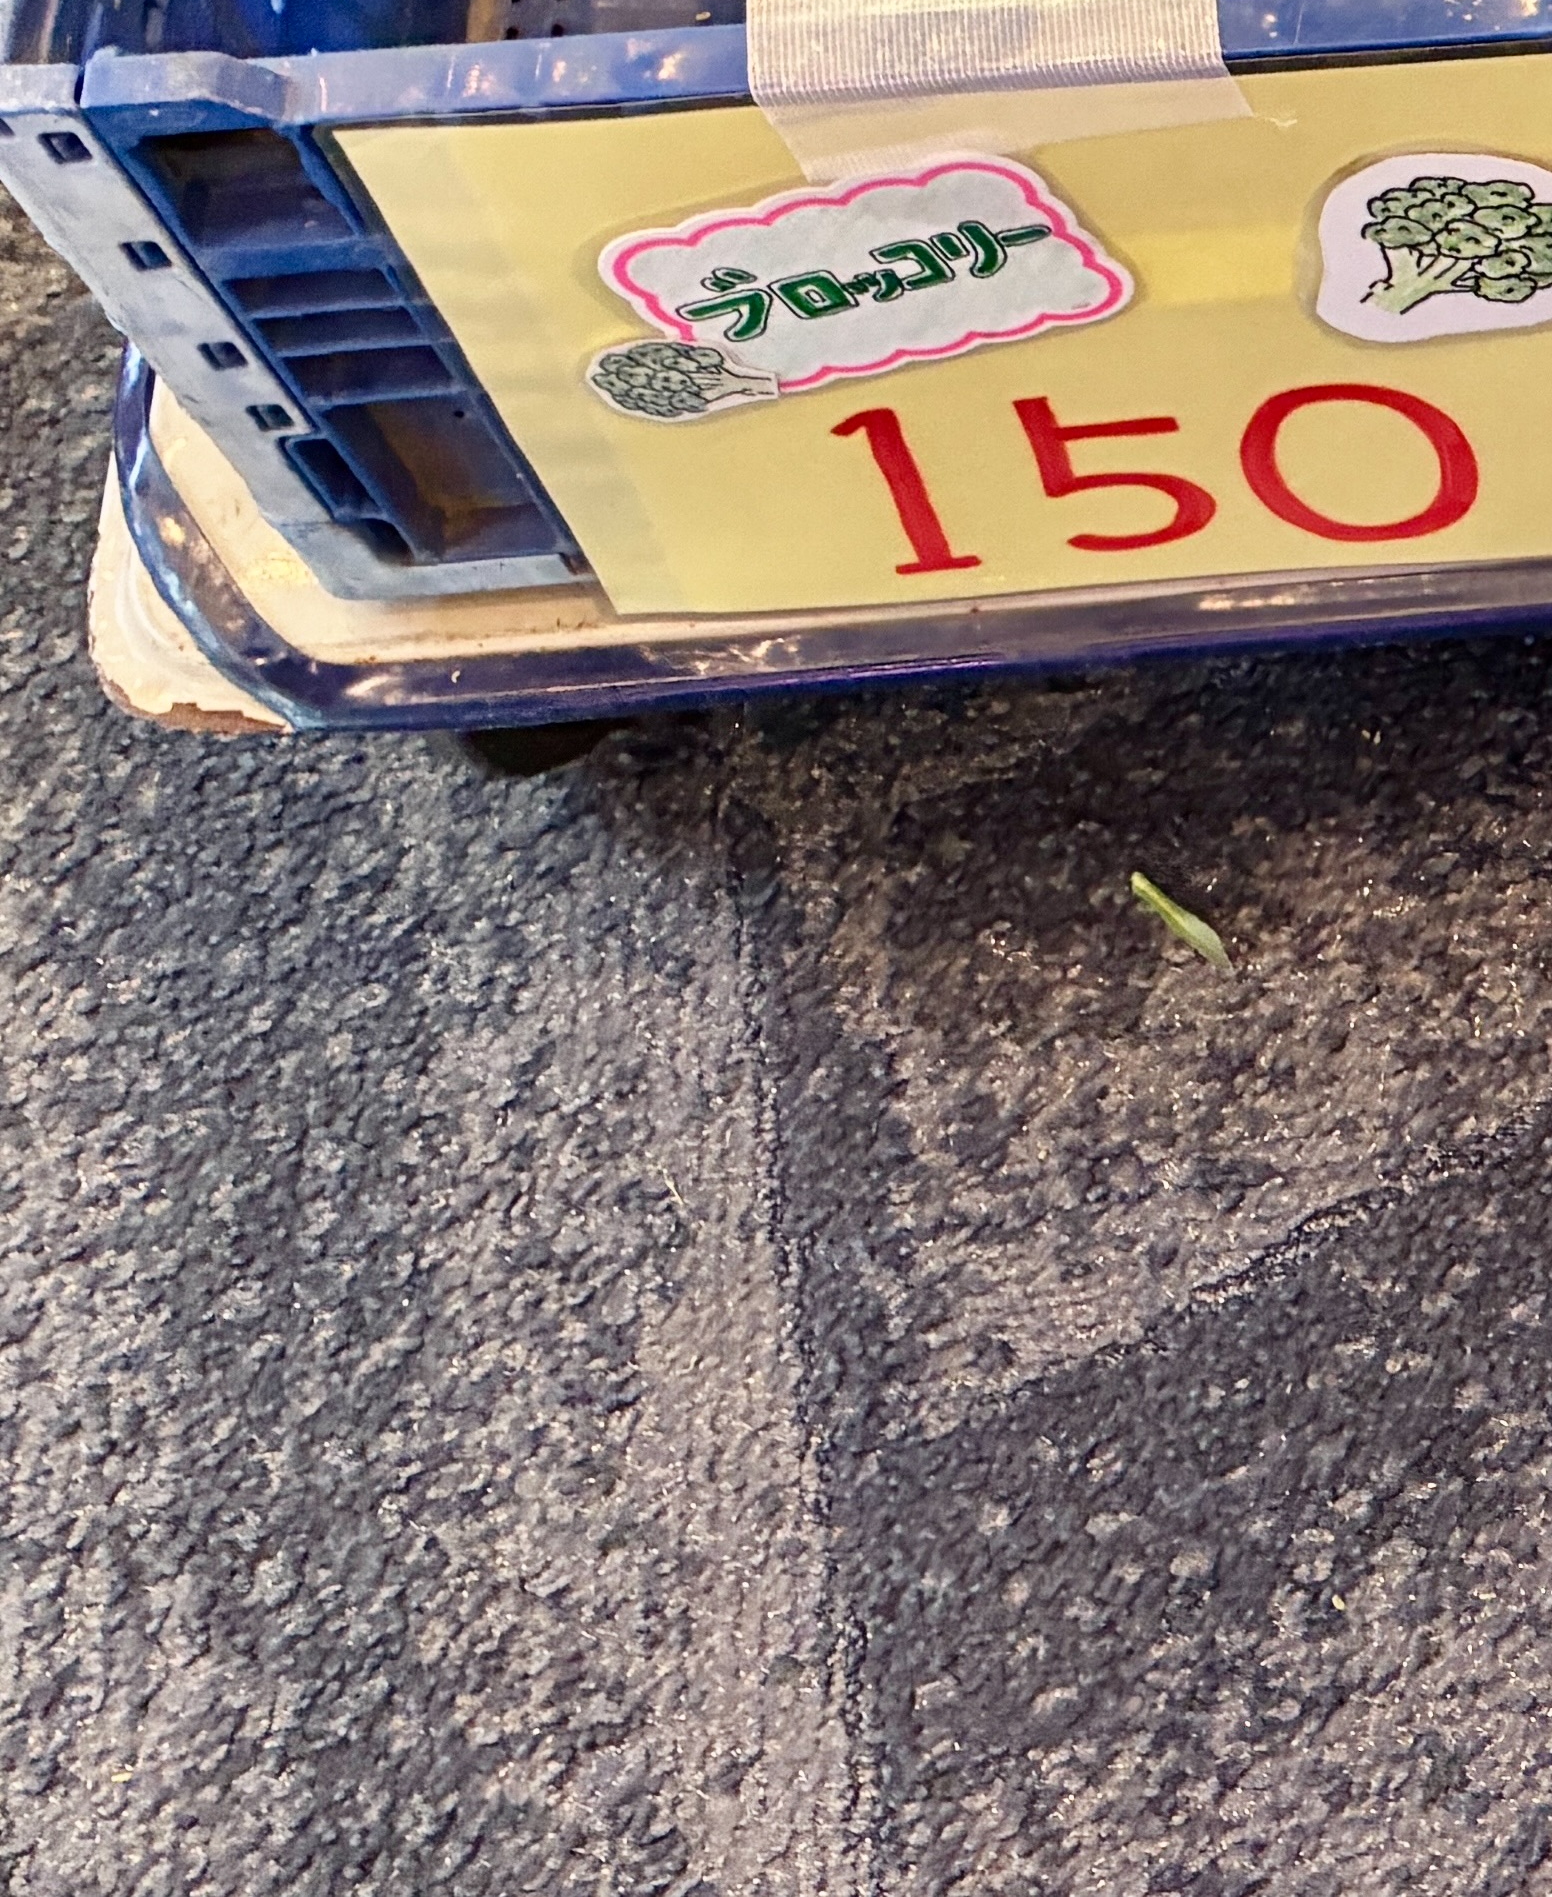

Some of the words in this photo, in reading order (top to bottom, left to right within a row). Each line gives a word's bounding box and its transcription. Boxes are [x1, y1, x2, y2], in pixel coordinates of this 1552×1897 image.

[676, 220, 1052, 342] ブロッコリー
